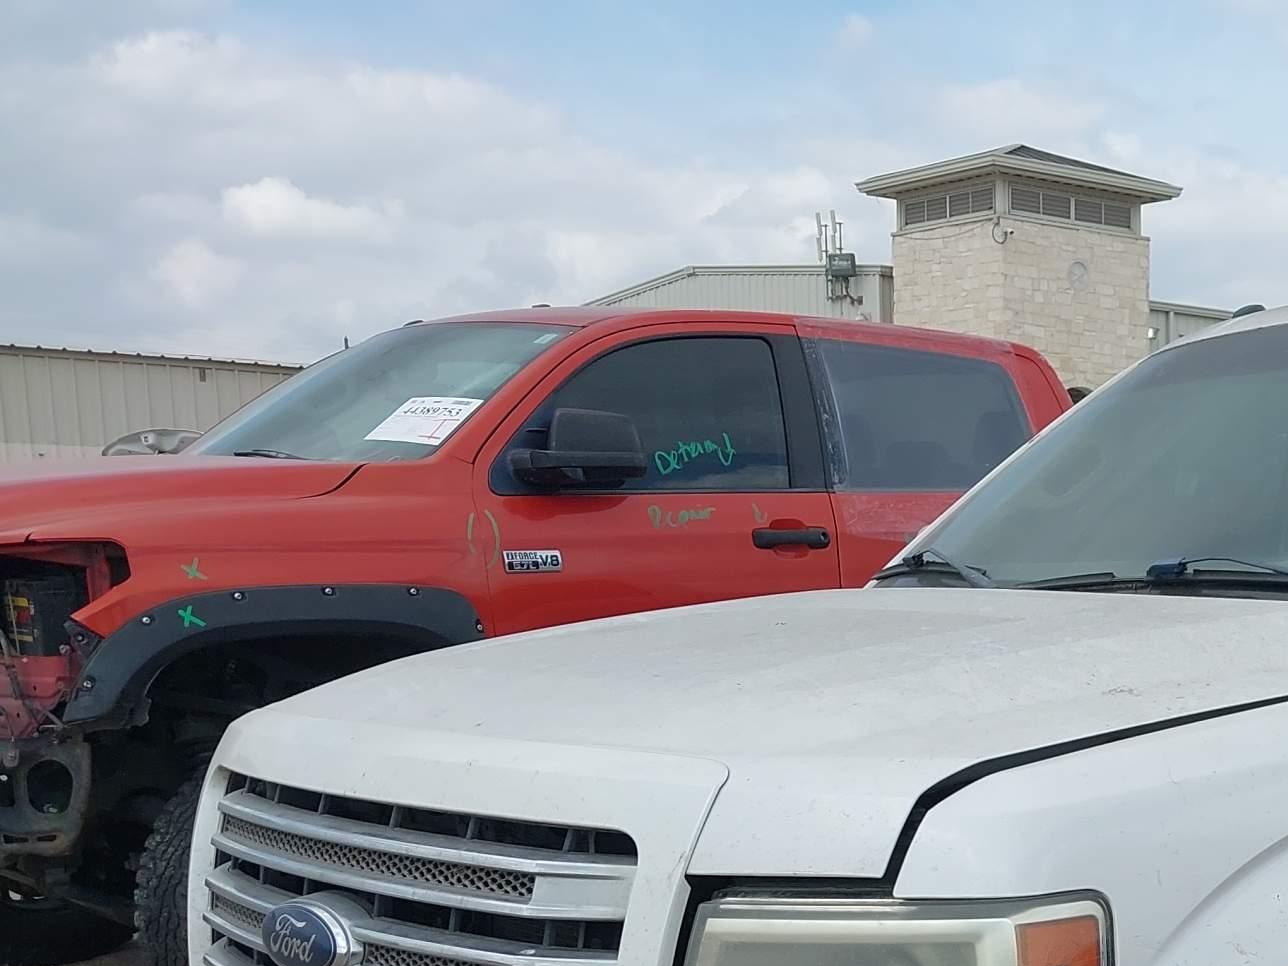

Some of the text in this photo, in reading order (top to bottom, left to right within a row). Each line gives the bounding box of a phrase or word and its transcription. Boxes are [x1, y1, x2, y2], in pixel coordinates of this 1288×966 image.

[402, 406, 463, 417] 44389753
[540, 554, 560, 567] V8
[270, 913, 317, 963] Ford
